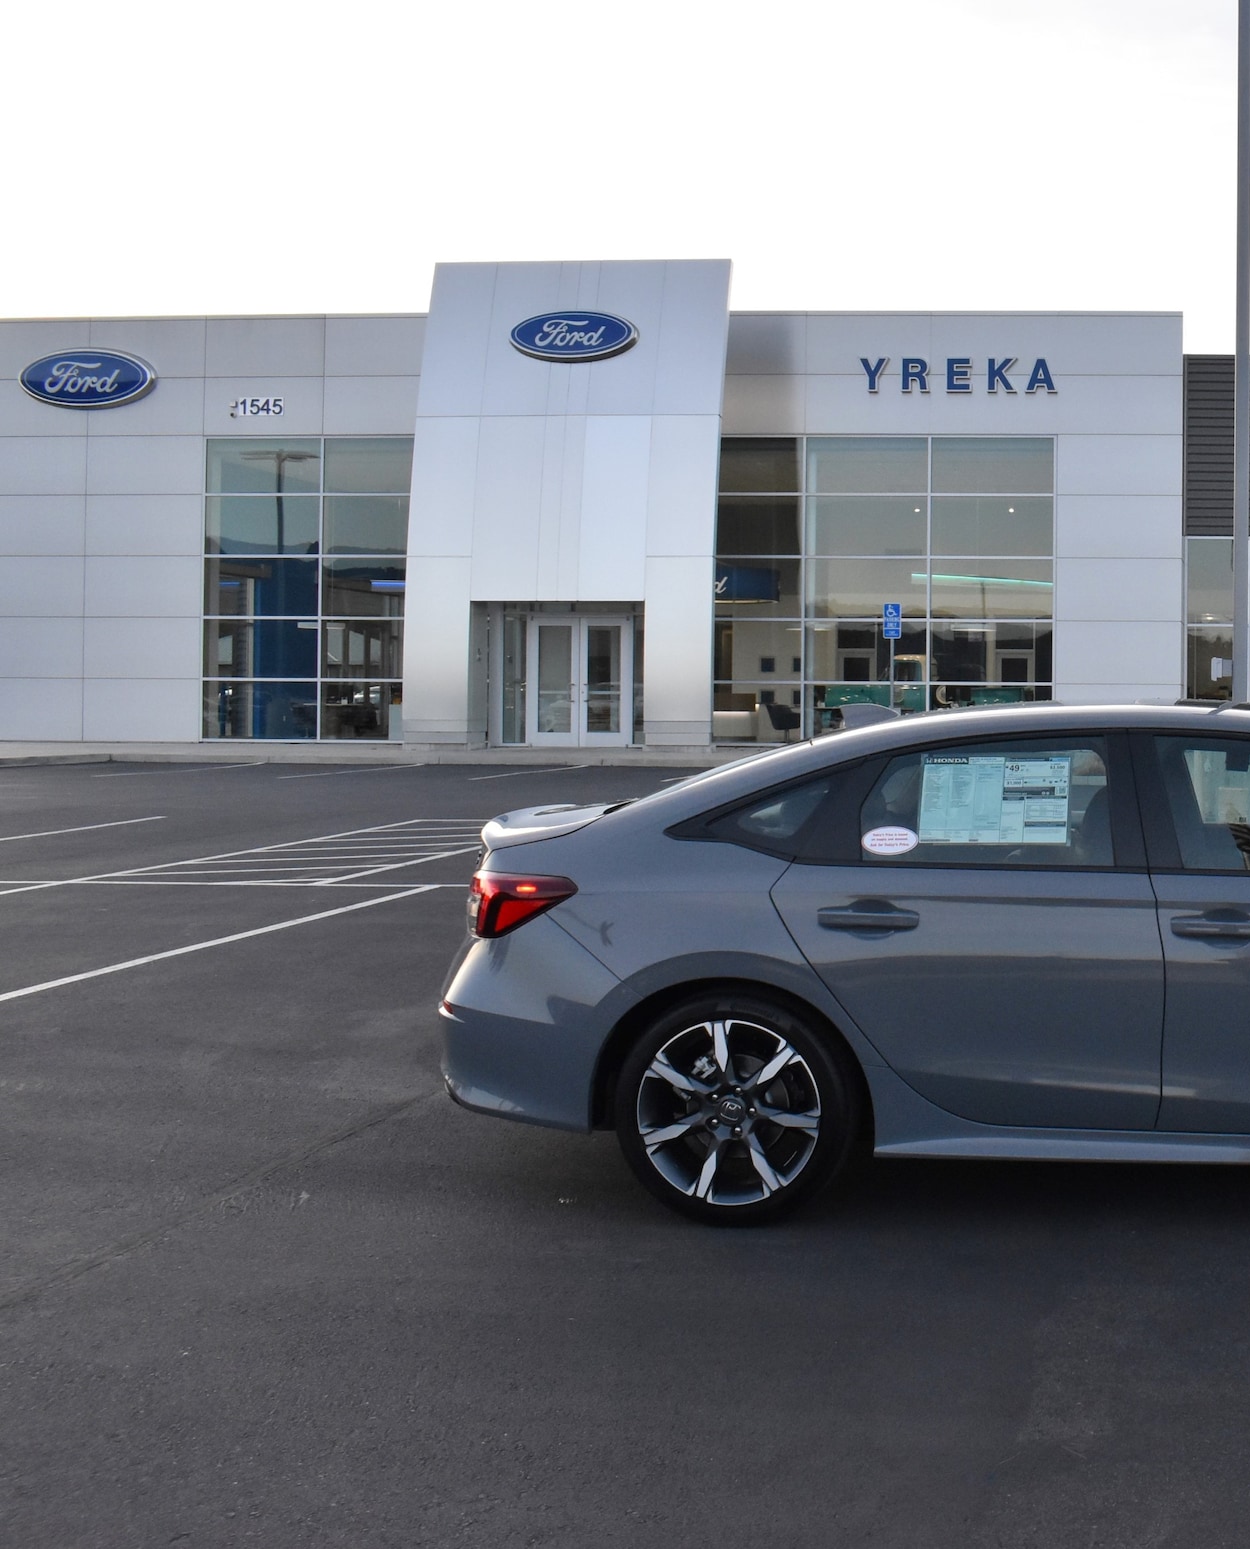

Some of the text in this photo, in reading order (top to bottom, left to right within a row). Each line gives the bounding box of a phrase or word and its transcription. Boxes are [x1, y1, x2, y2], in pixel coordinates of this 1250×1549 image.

[535, 319, 606, 347] Ford
[44, 361, 121, 394] Ford
[859, 357, 1058, 394] YREKA
[239, 398, 284, 416] 1545
